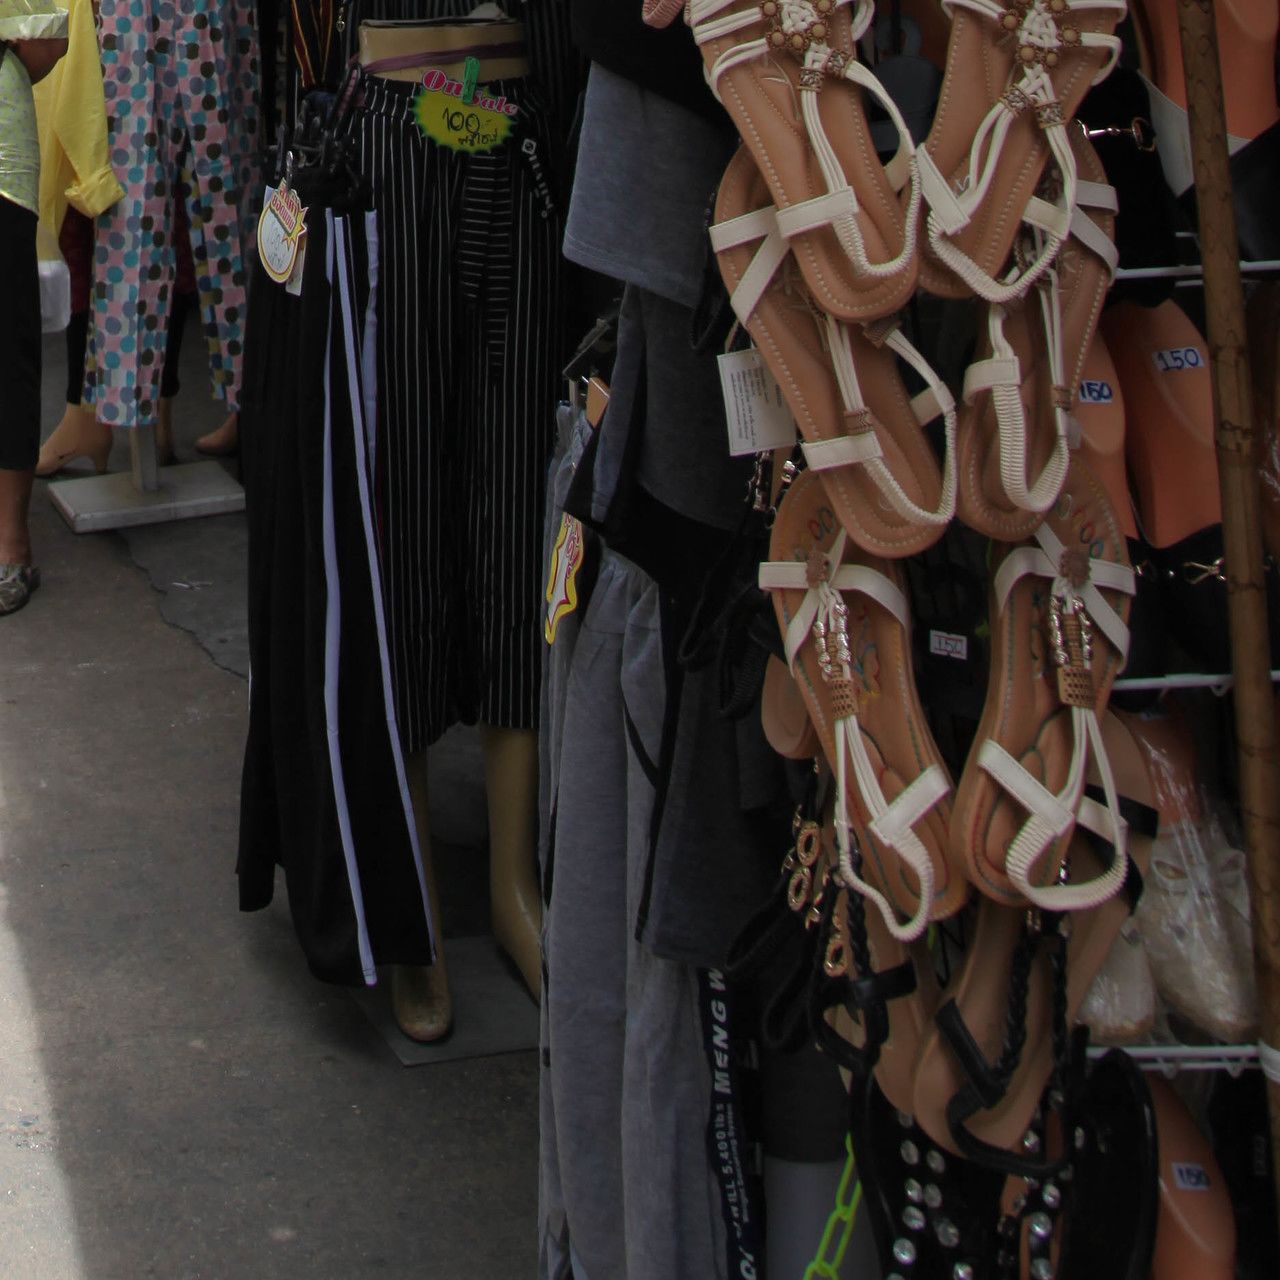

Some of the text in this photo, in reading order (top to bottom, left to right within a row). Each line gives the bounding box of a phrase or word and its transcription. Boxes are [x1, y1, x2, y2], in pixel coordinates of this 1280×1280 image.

[423, 69, 463, 96] On
[1158, 350, 1200, 371] 150
[1079, 381, 1113, 400] 150
[711, 998, 733, 1095] MENG
